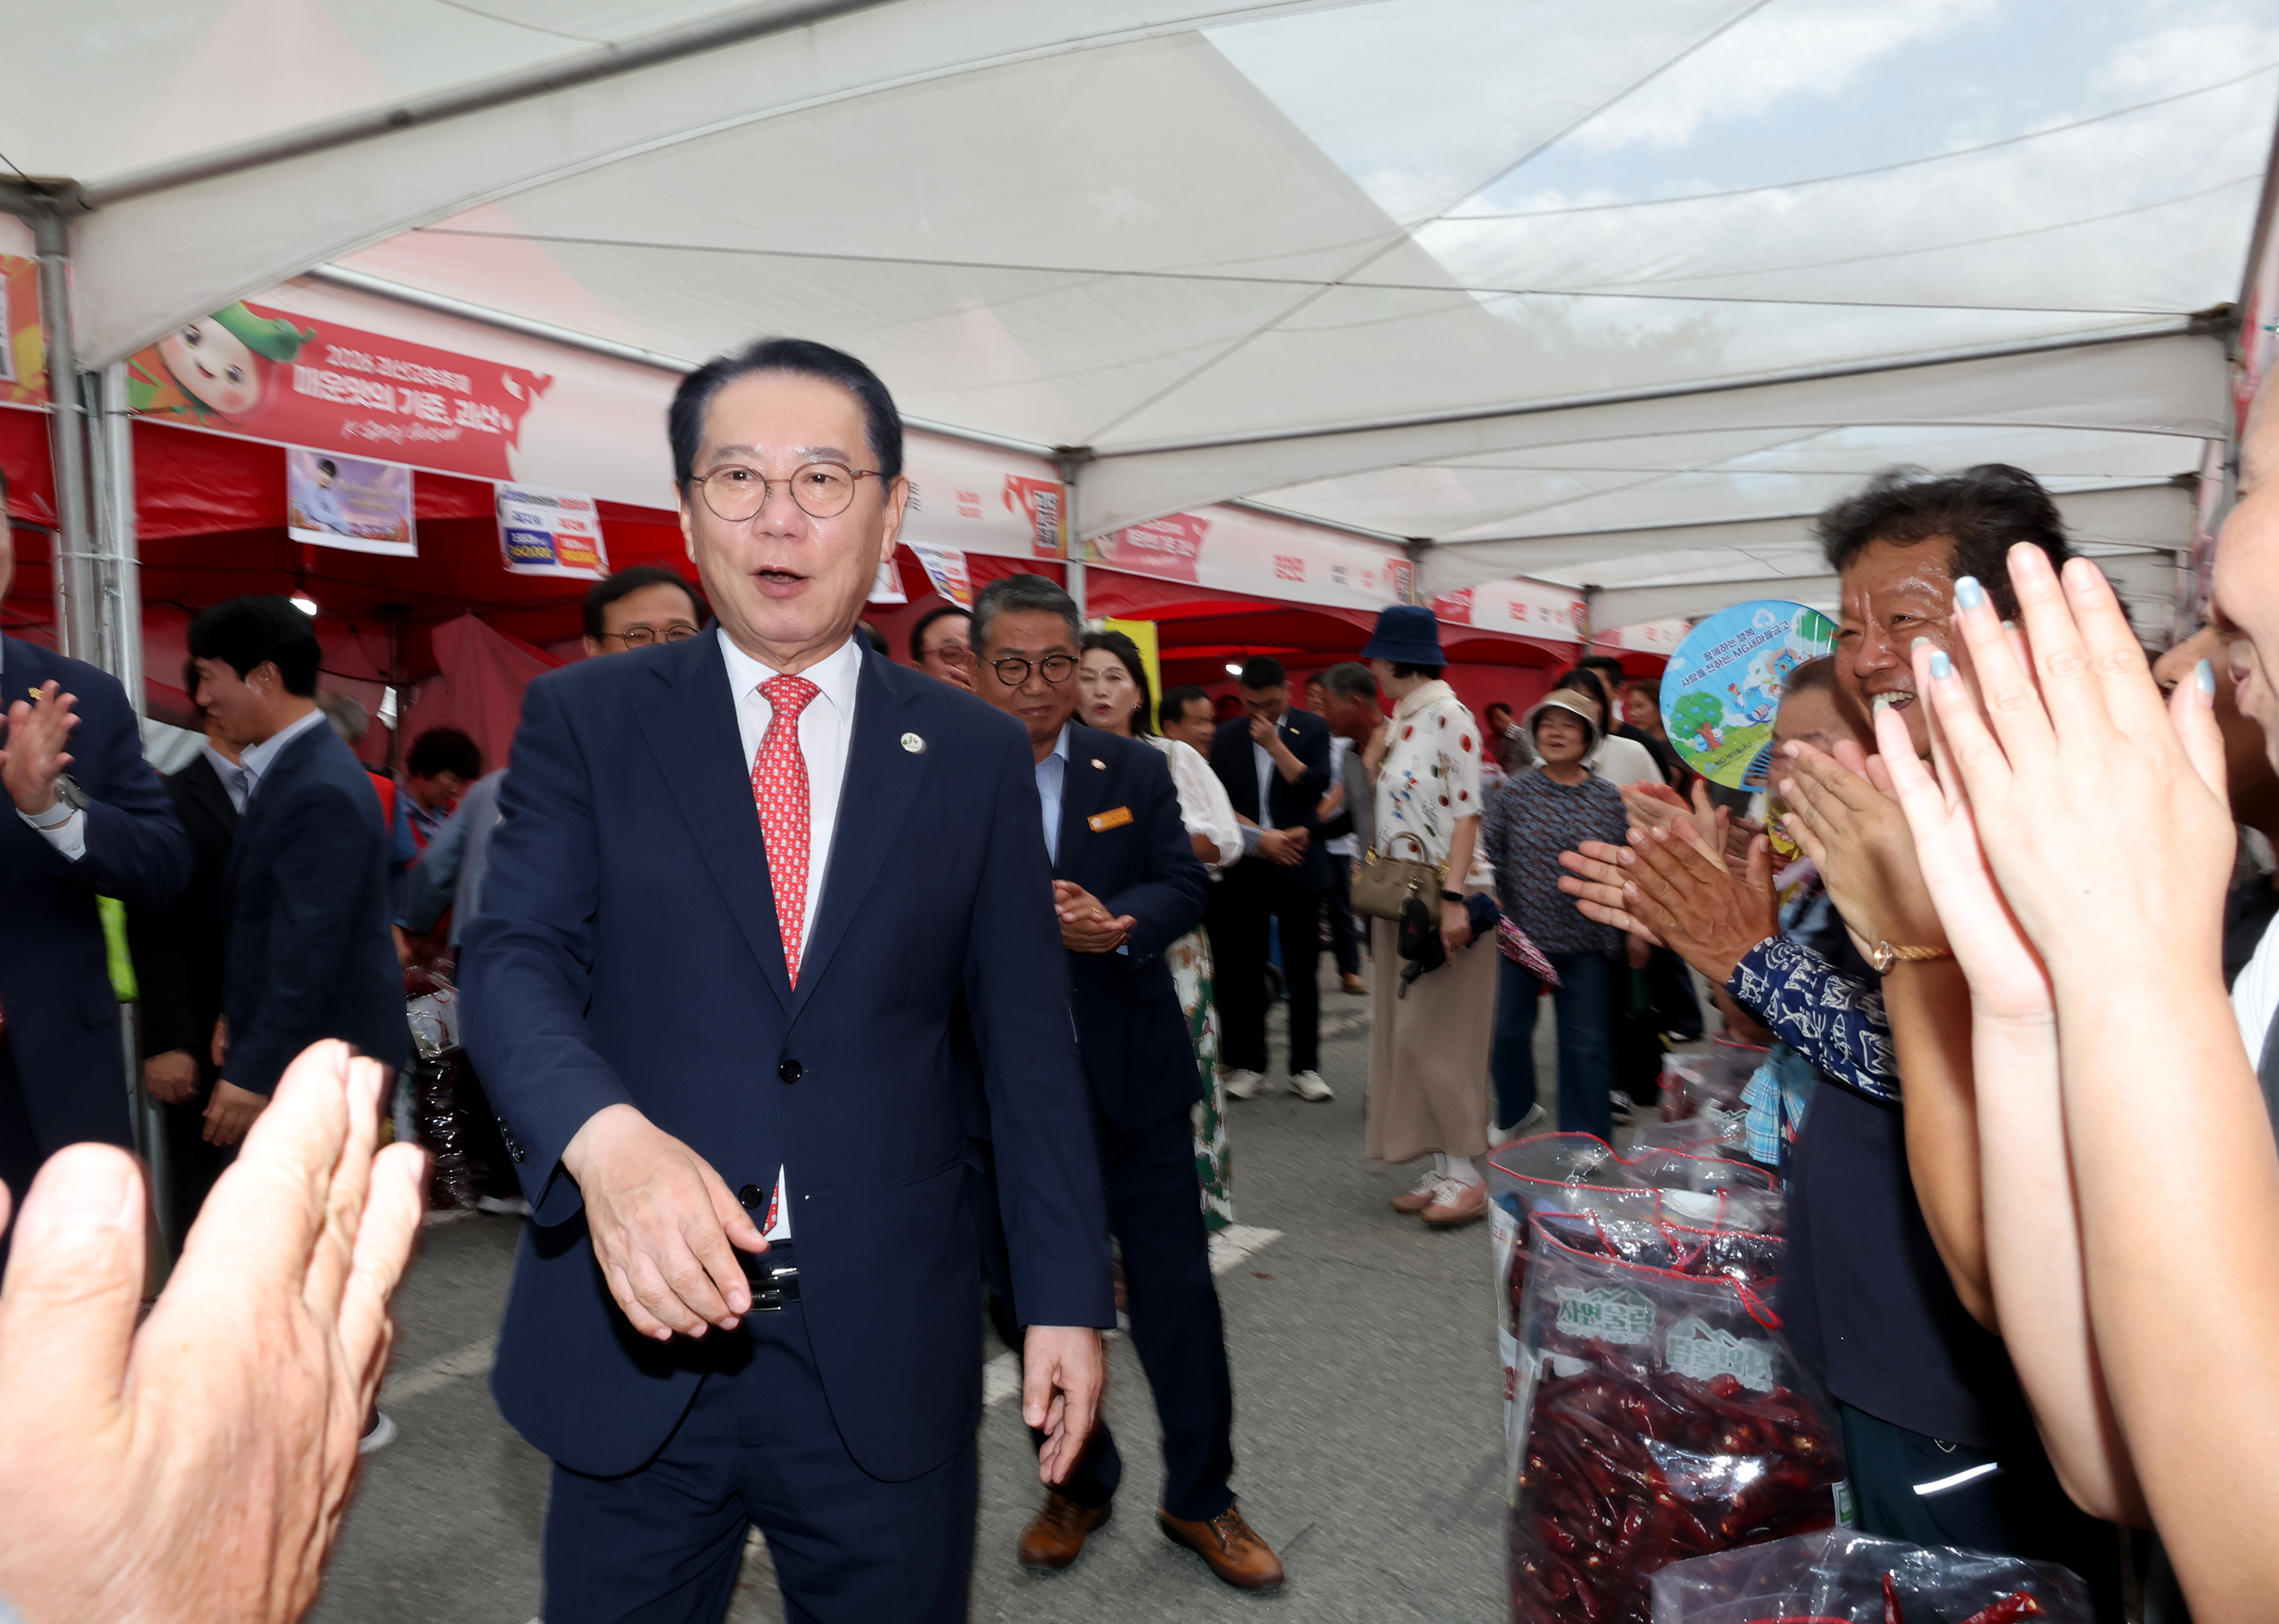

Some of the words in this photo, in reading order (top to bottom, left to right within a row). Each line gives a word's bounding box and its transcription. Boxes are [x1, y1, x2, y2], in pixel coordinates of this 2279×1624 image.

[1680, 668, 1707, 688] 사랑을
[1705, 655, 1734, 674] 전하는,
[1733, 621, 1791, 659] MG새마을금고
[1702, 640, 1737, 662] 함께하는
[1736, 627, 1756, 643] 행복
[1714, 757, 1727, 766] MG
[1726, 742, 1753, 759] 새마을금고
